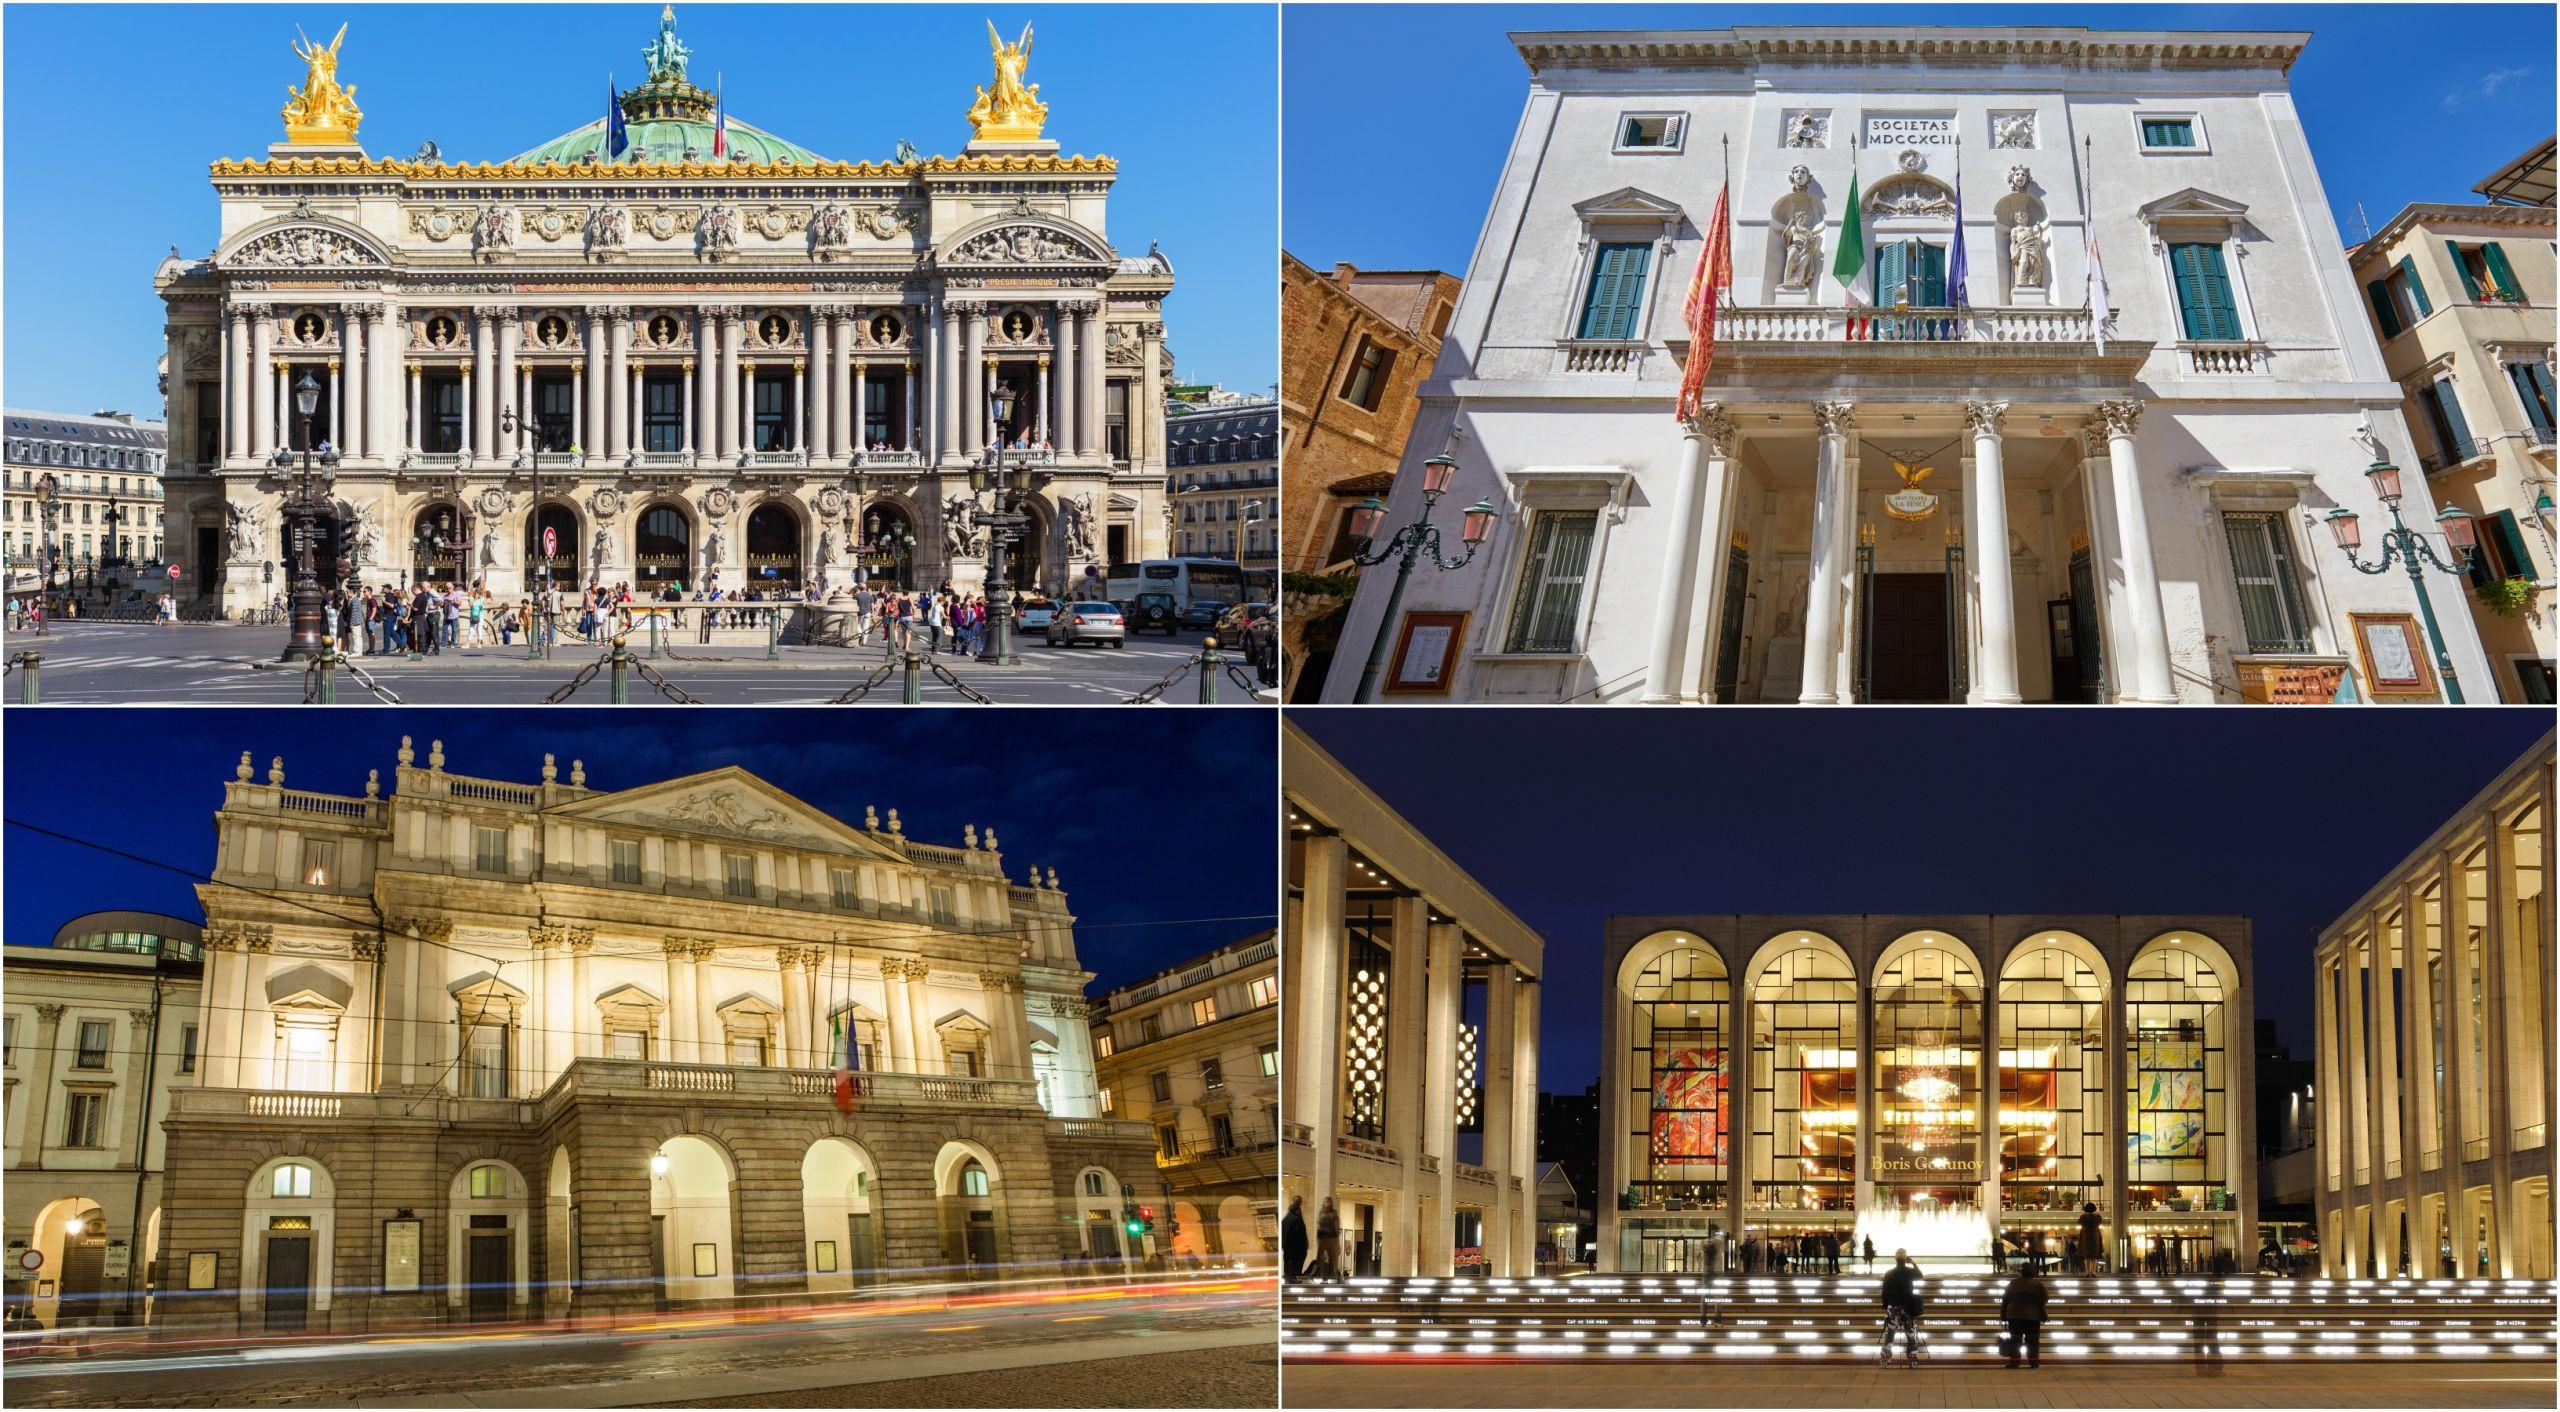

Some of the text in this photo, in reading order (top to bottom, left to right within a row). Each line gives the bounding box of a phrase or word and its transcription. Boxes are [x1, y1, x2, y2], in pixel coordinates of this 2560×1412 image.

[1873, 121, 1949, 131] SOCIETAS
[1869, 134, 1952, 145] MDCCXCII
[621, 283, 684, 291] NATIONALE
[695, 283, 711, 291] DE
[724, 283, 784, 291] MUSIQUE
[1871, 1156, 1911, 1170] Boris
